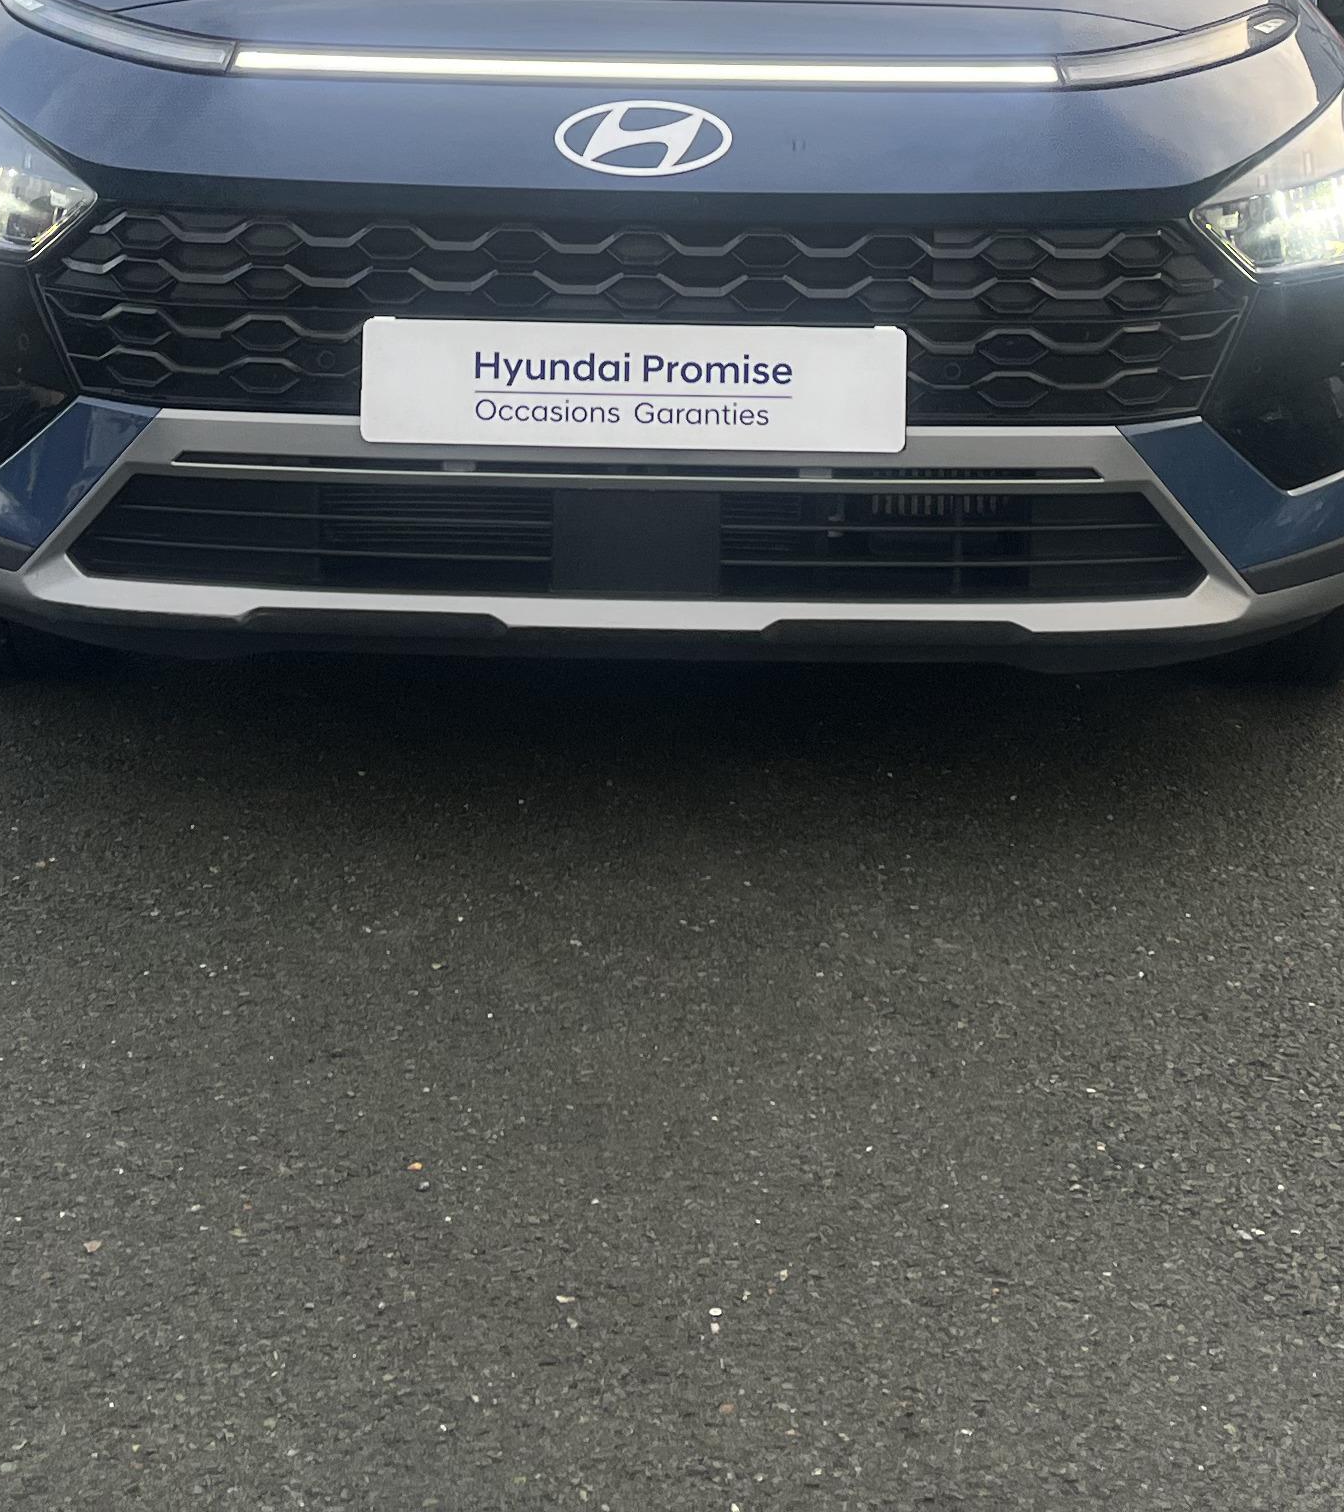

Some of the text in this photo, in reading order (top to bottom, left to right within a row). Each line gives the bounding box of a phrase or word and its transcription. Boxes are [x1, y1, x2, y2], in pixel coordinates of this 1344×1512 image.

[474, 351, 794, 386] Hyundai Promise
[475, 399, 770, 427] Occasions Garanties
